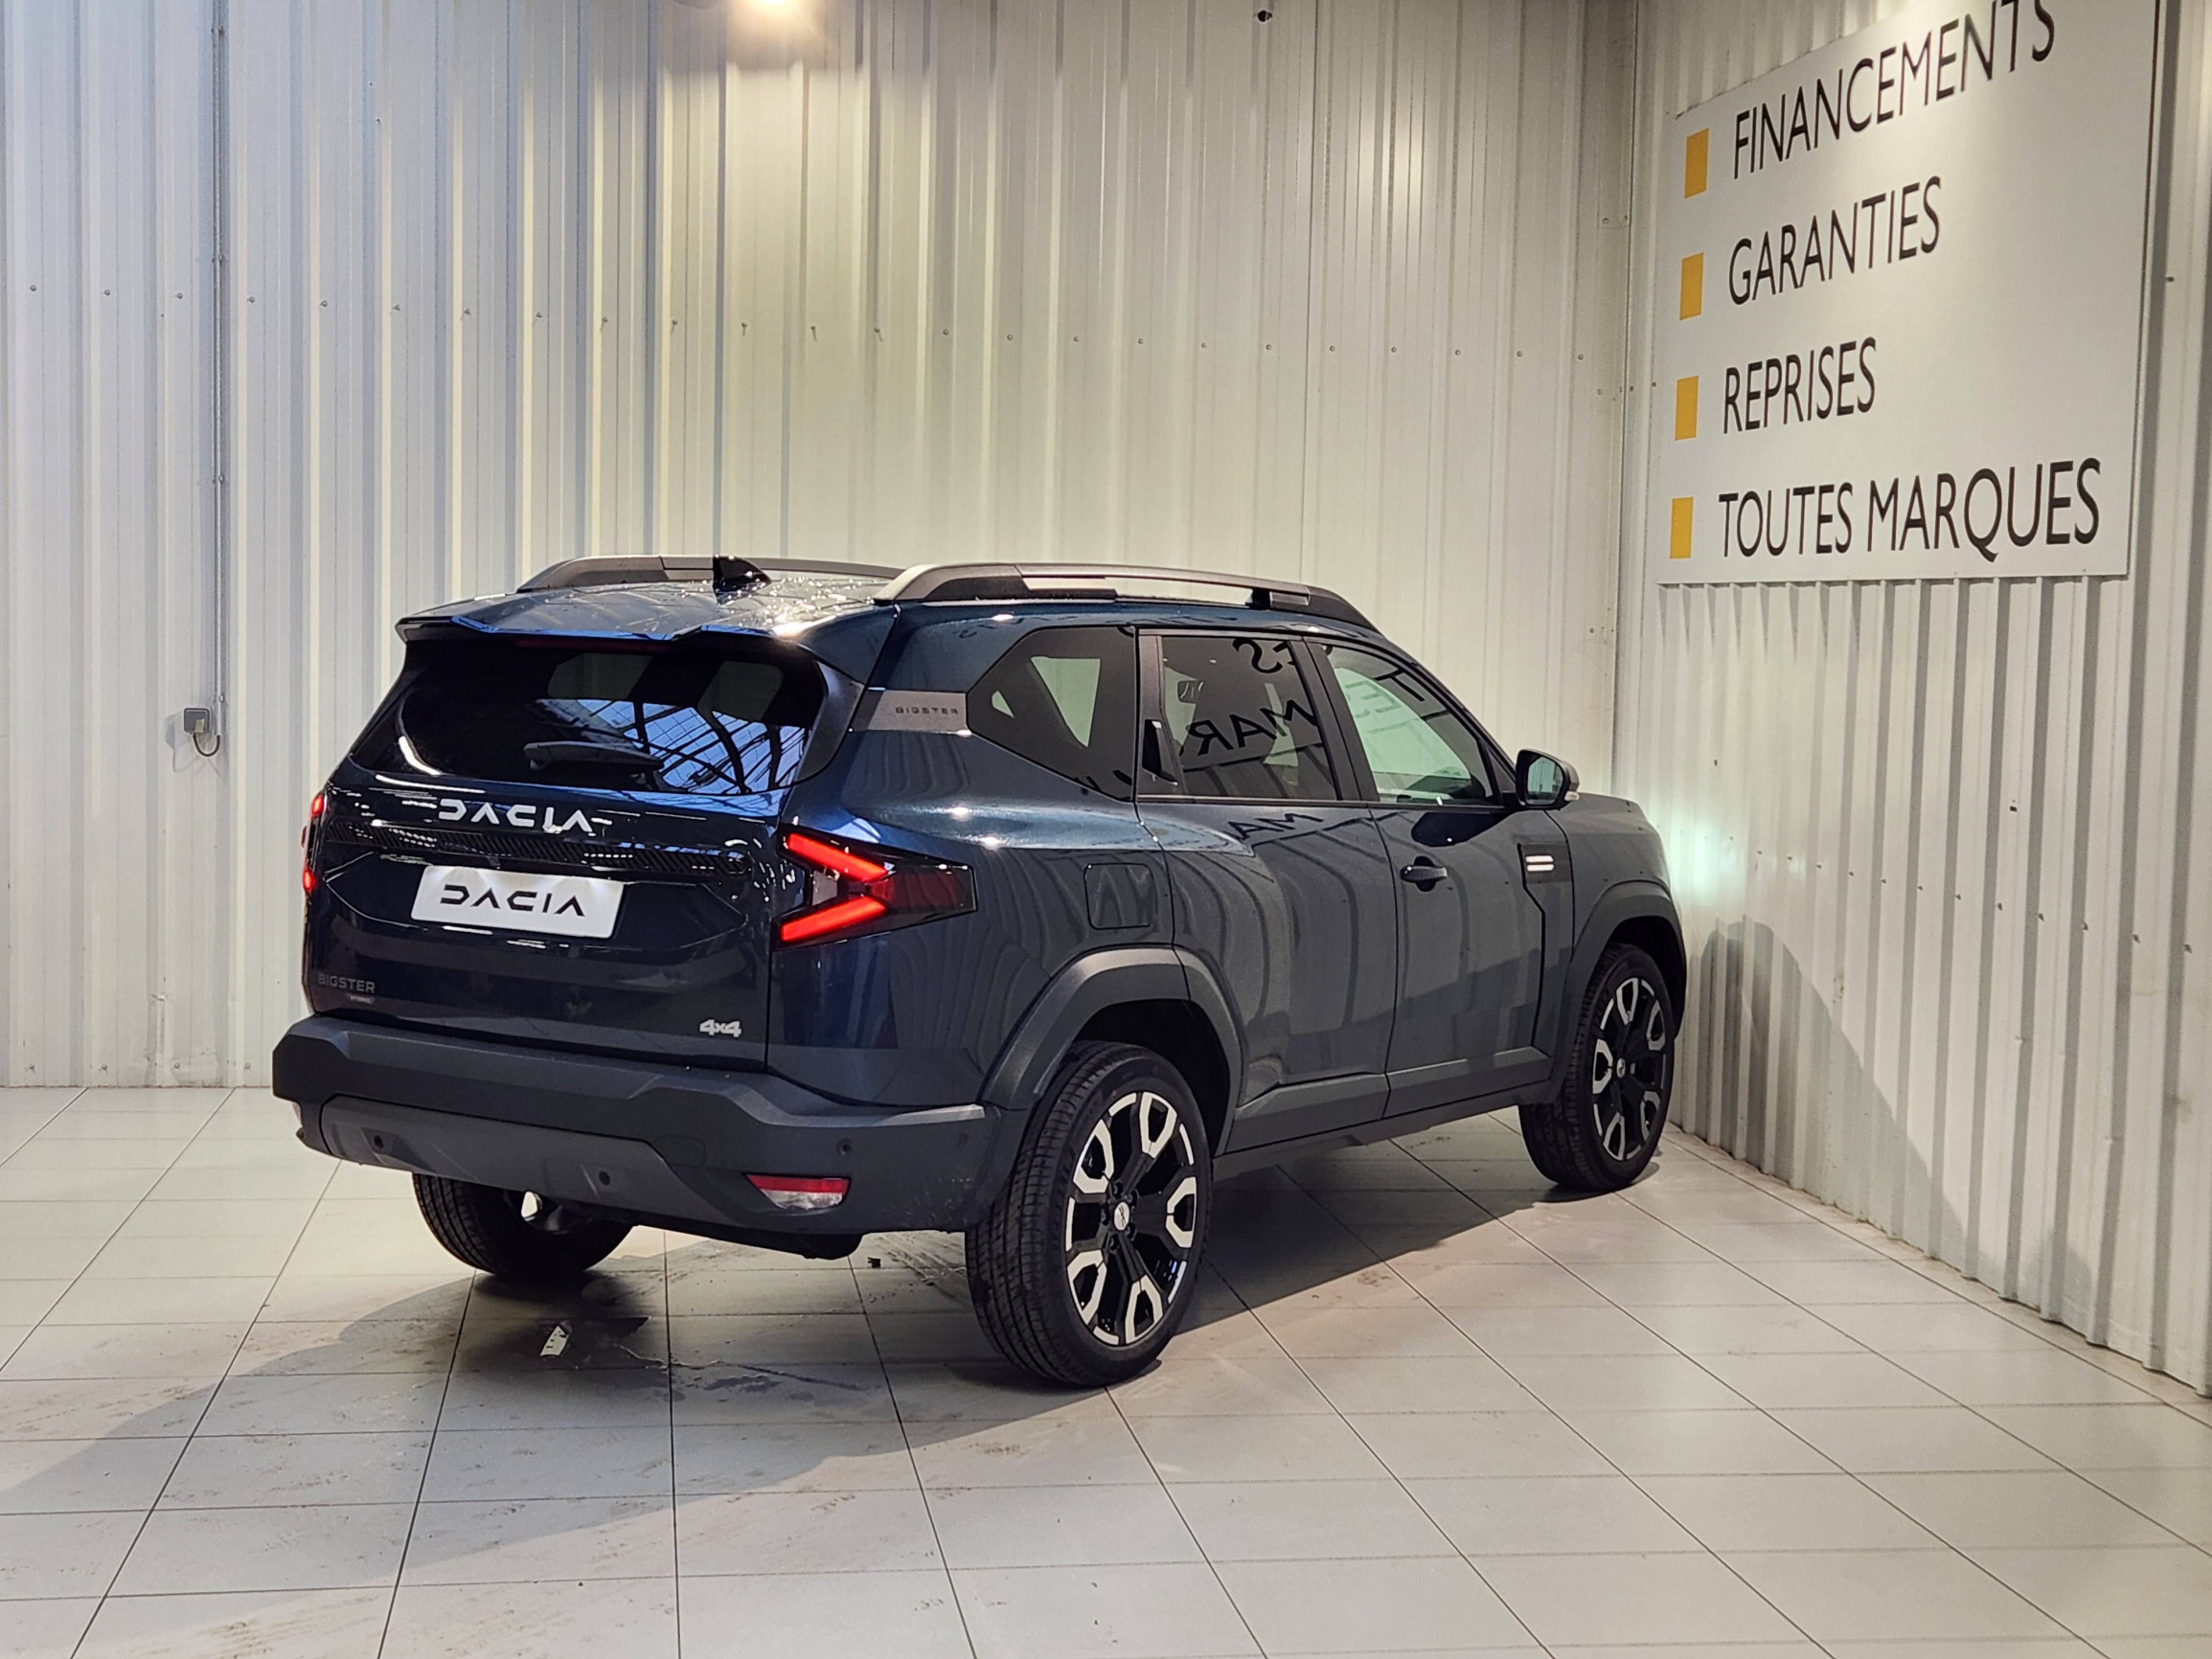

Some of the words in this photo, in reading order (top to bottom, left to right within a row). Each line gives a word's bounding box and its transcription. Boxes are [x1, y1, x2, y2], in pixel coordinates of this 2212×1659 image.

[1734, 0, 2055, 180] FINANCEMENTS
[1728, 175, 1941, 306] GARANTIES
[1723, 336, 1877, 434] REPRISES
[1718, 482, 1853, 557] TOUTES
[1867, 458, 2101, 563] MARQUES
[439, 798, 593, 833] DACIA
[440, 884, 585, 917] DACIA
[318, 972, 376, 993] BIGSTER
[699, 1018, 742, 1038] 4x4
